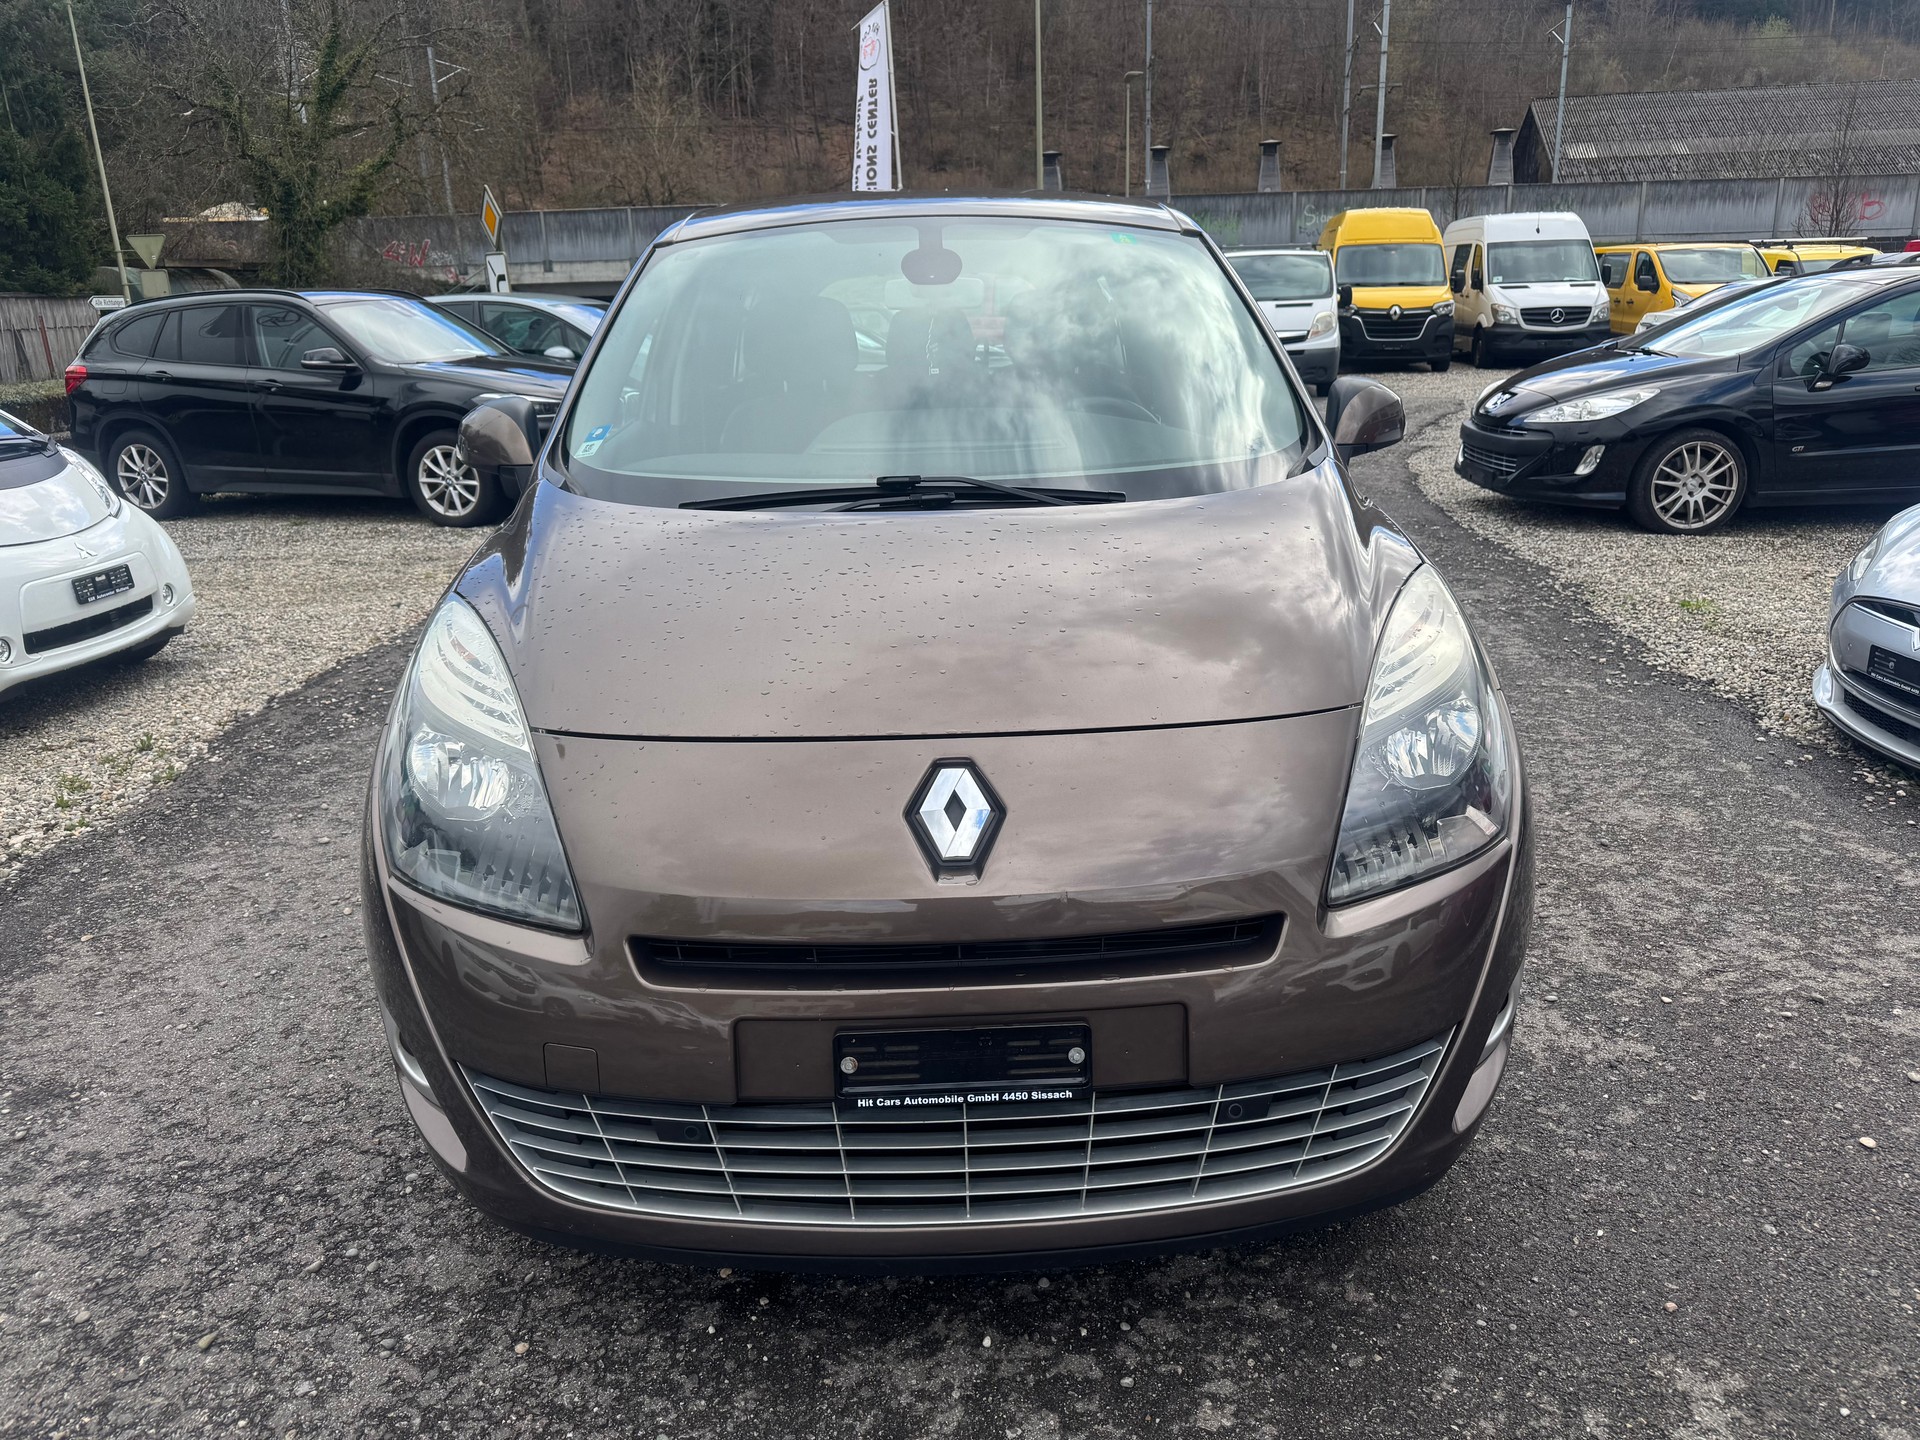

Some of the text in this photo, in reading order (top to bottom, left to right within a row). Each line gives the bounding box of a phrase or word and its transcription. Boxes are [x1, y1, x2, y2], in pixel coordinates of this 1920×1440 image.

[857, 1090, 1073, 1107] Hit Cars Automobile GmbH 4450 Sissach
